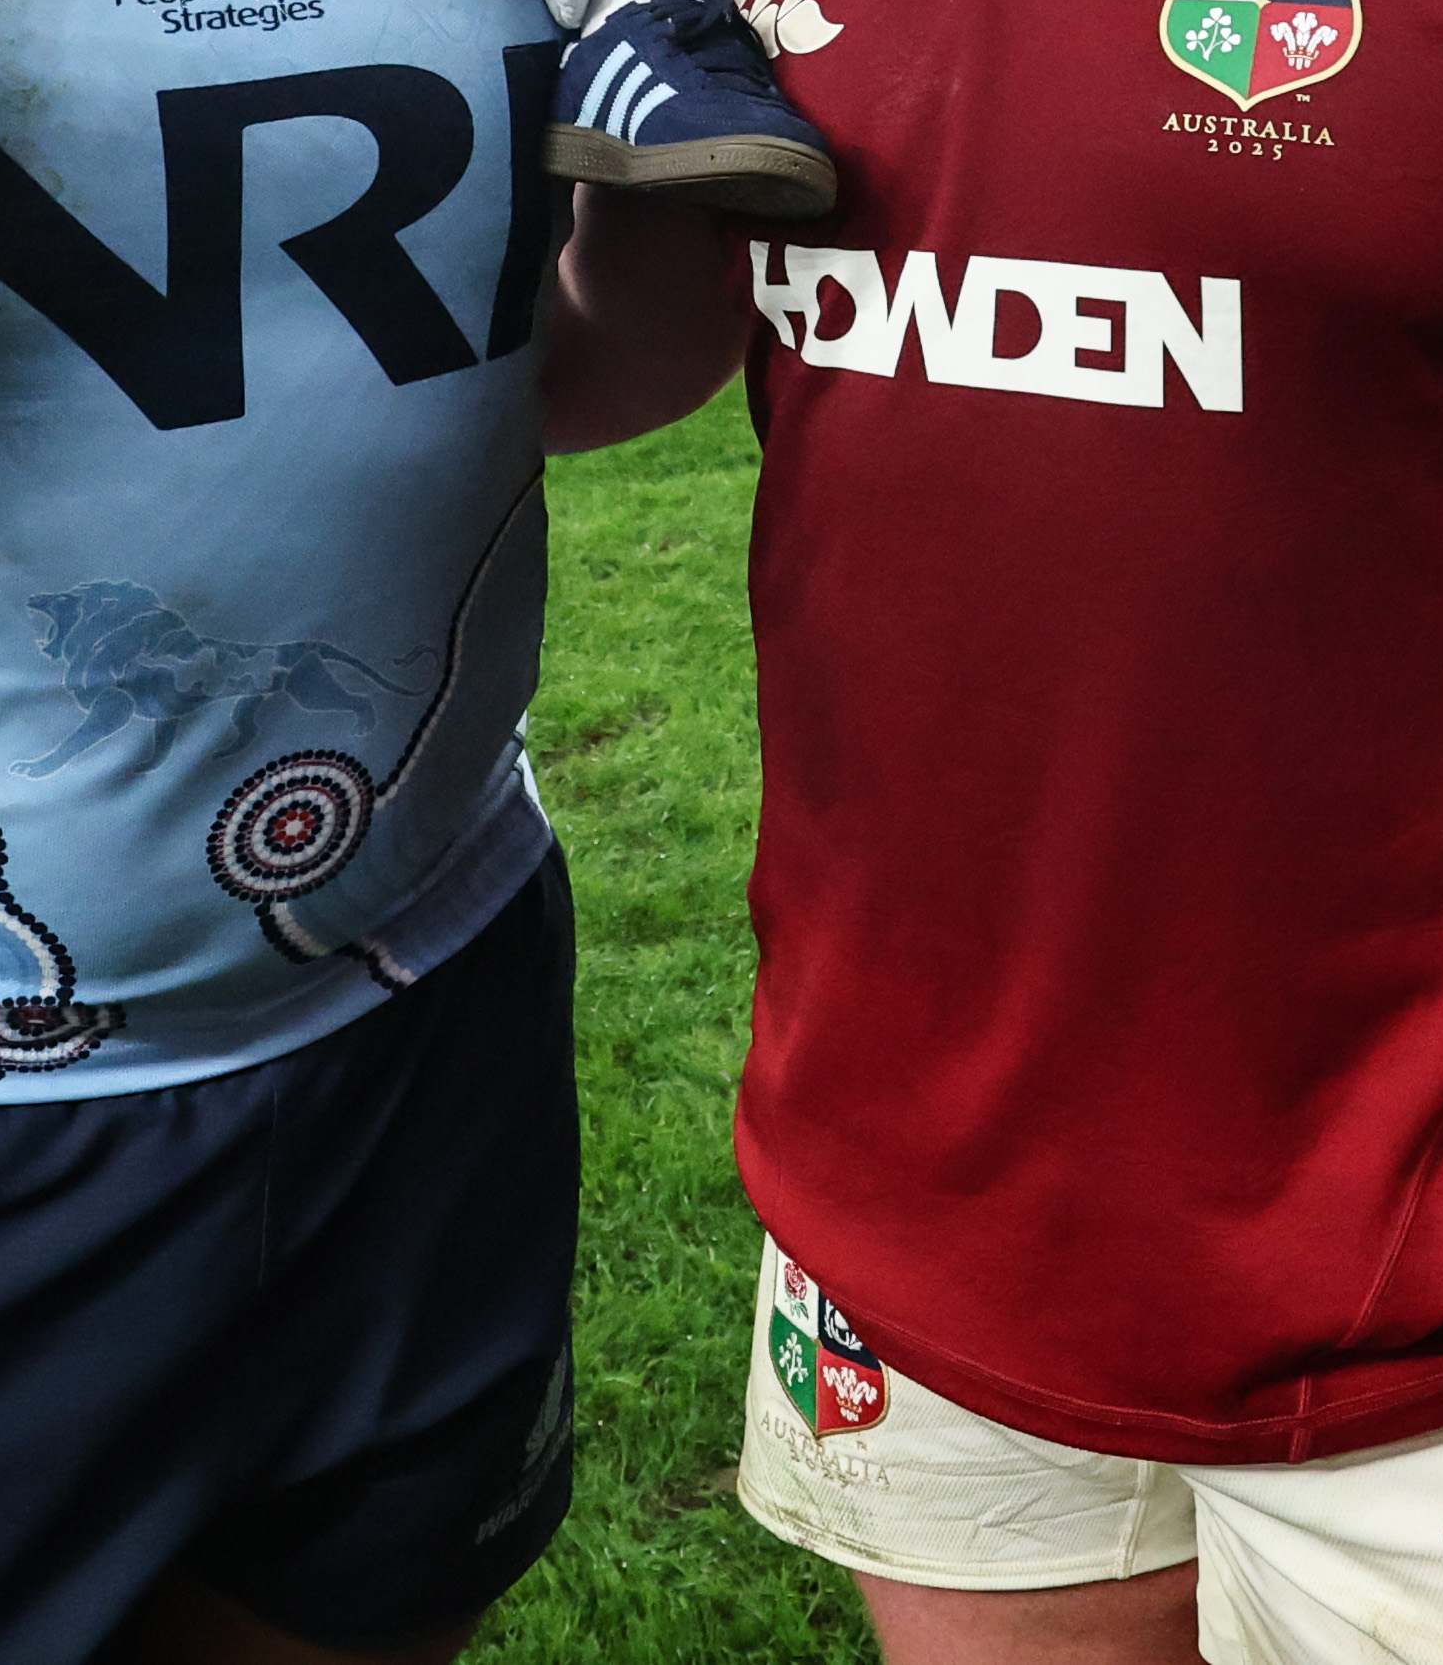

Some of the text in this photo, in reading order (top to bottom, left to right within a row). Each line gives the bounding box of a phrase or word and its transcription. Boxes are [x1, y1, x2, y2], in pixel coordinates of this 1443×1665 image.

[1162, 113, 1335, 147] AUSTRALIA
[1207, 138, 1284, 161] 2025
[749, 239, 1243, 412] HOWDEN
[760, 1409, 892, 1491] AUSTRALIA
